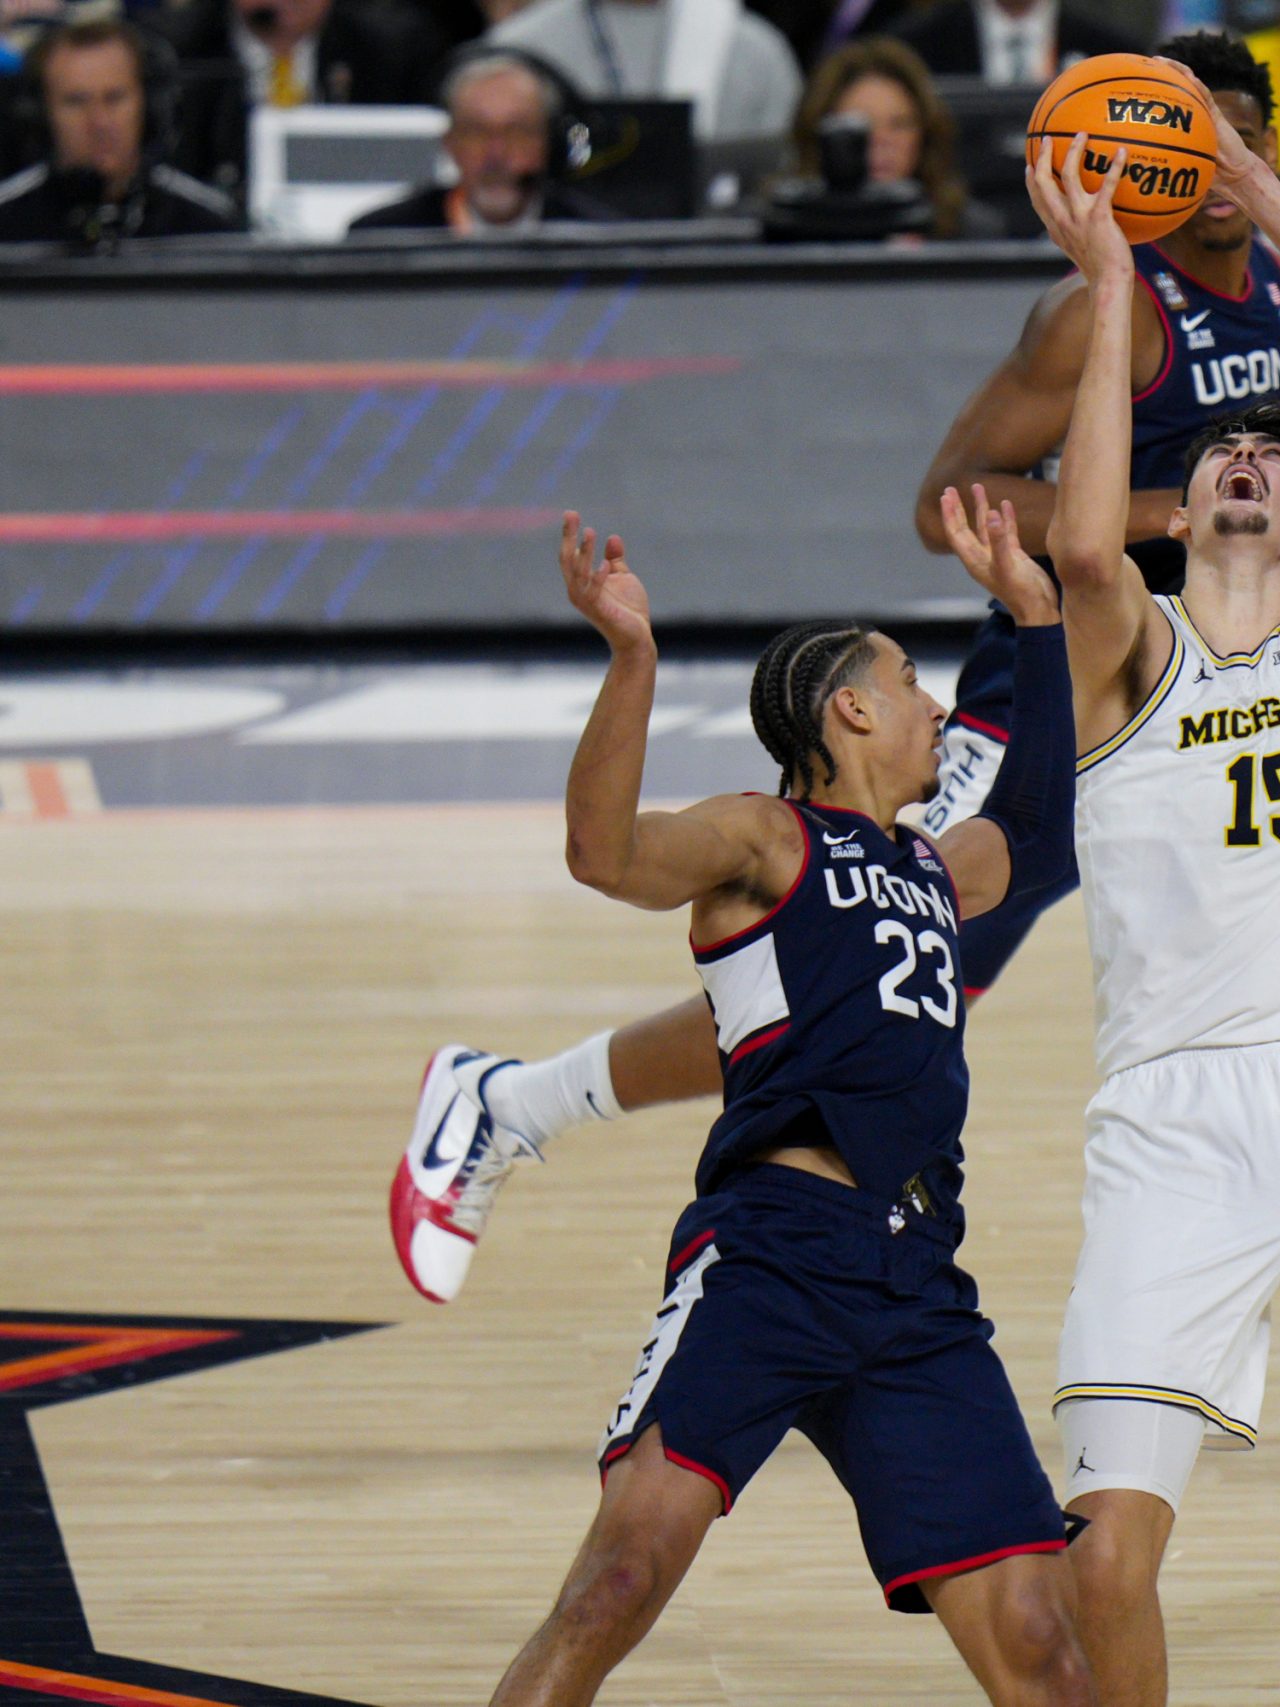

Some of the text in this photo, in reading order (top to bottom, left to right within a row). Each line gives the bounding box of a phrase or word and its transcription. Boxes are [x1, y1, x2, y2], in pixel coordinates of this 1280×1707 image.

[1107, 98, 1193, 133] NCAA
[830, 848, 865, 859] CHANGE
[824, 865, 958, 936] UCONN
[874, 919, 957, 1028] 23
